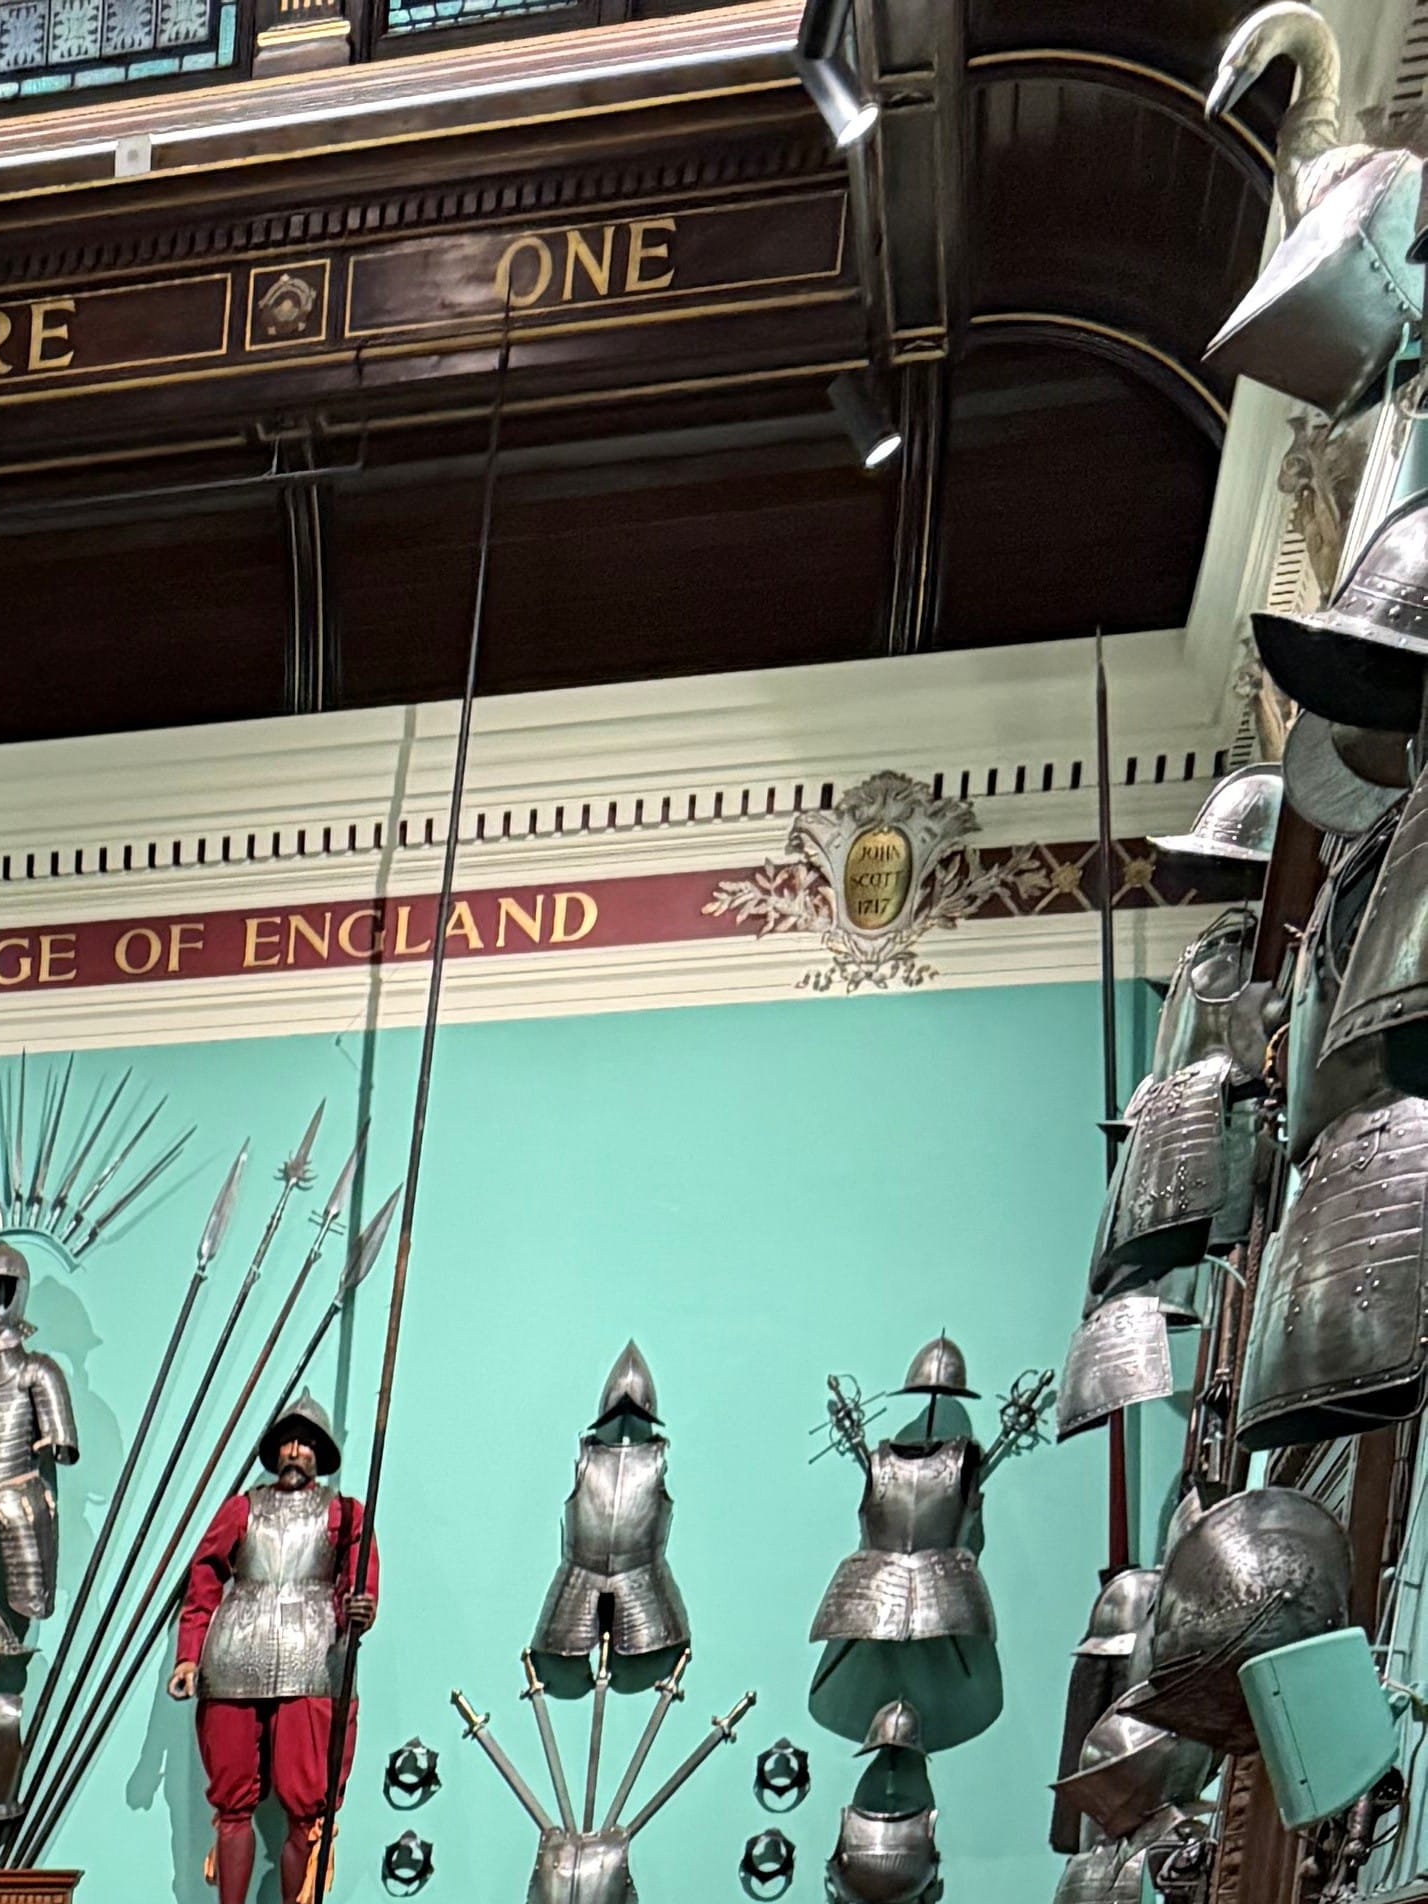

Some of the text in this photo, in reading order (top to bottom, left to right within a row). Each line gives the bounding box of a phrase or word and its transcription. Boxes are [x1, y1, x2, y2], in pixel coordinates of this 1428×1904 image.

[495, 217, 679, 309] ONE
[857, 844, 902, 863] JOHN
[850, 871, 906, 888] SCOTT
[857, 899, 893, 916] 1717
[114, 922, 205, 976] OF
[243, 891, 600, 970] ENGLAND
